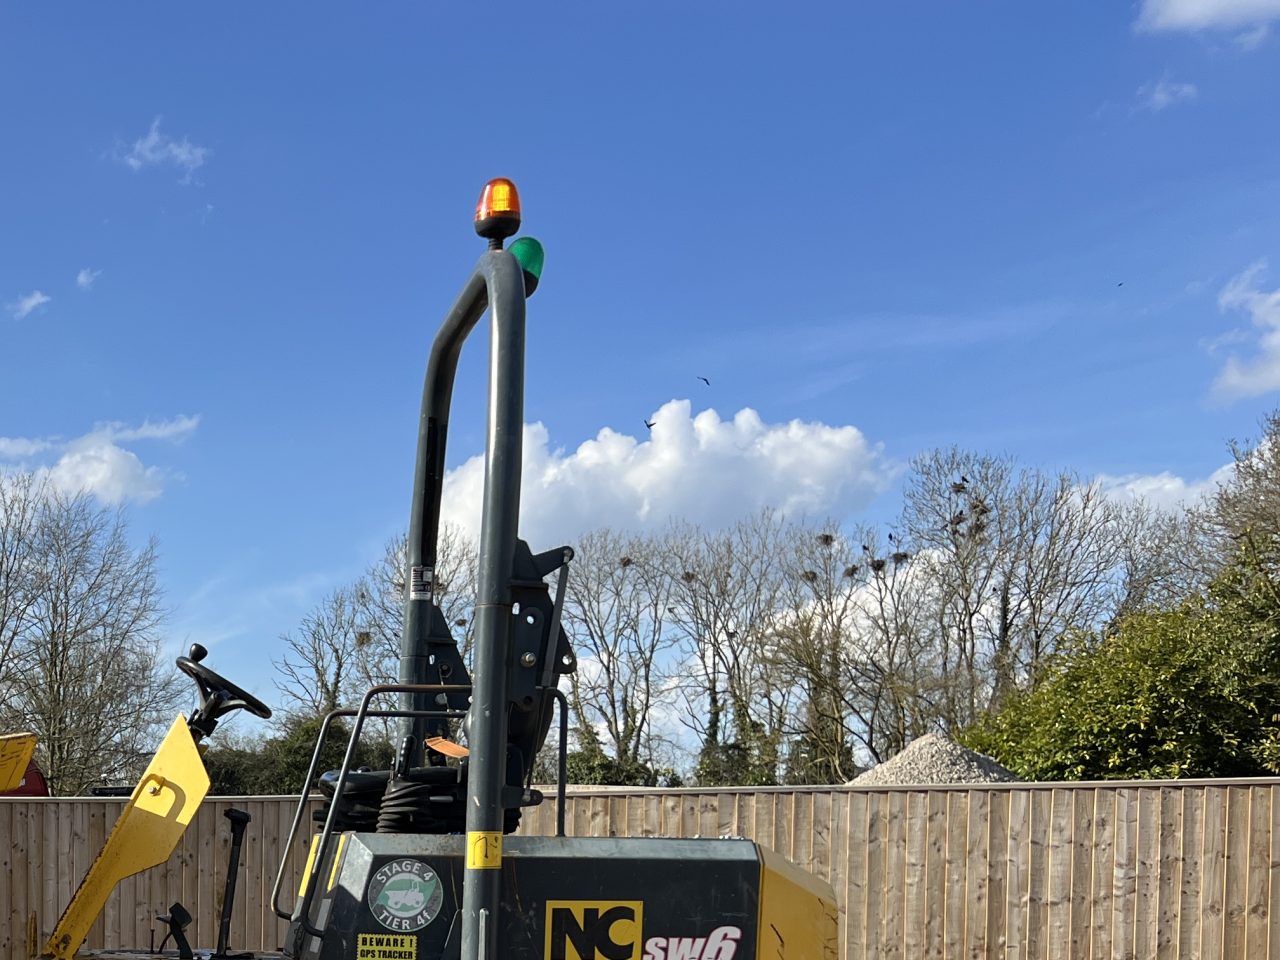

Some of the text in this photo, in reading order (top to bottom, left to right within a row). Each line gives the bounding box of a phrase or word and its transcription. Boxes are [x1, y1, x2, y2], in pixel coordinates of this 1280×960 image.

[376, 860, 434, 883] STAGE 4
[379, 909, 431, 930] TIER 4f
[361, 936, 405, 948] BEWARE
[550, 906, 635, 960] NC
[360, 949, 413, 959] GPS TRACKER
